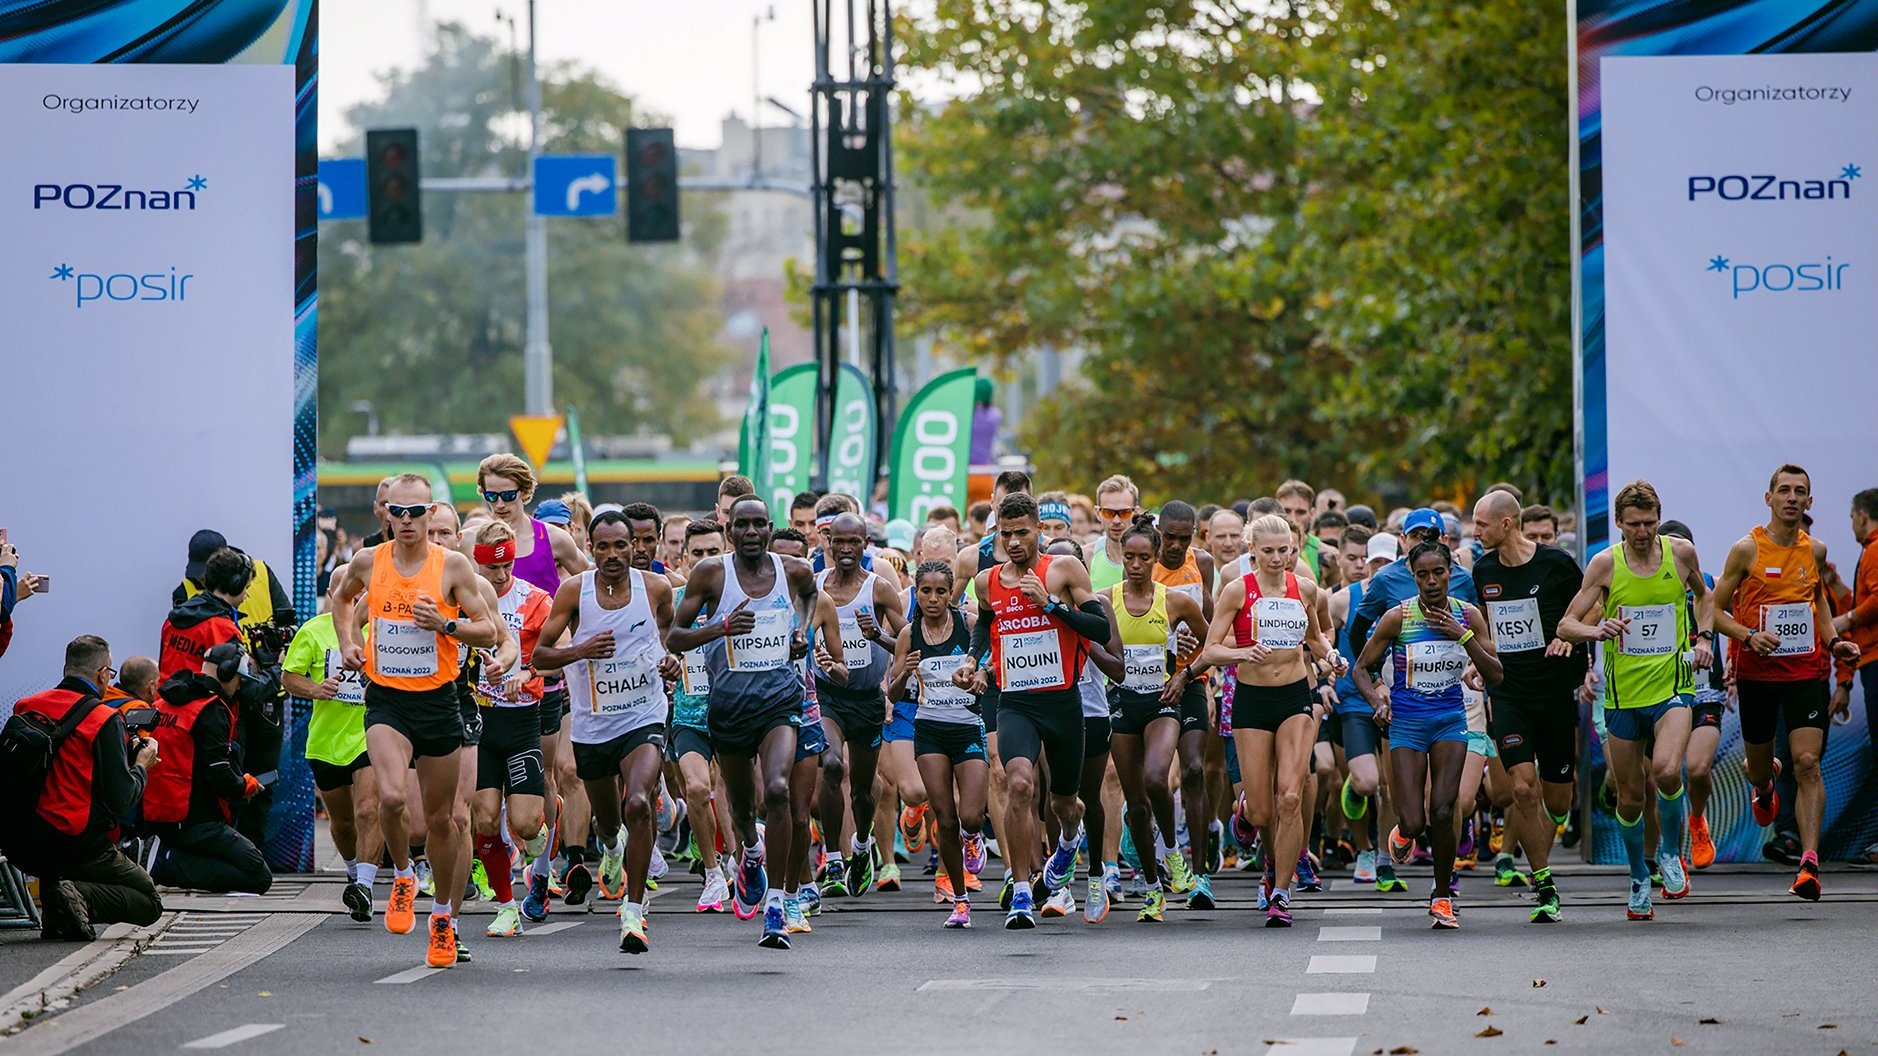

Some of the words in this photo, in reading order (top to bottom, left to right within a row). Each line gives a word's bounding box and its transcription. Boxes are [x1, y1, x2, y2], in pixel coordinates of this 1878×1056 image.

[1695, 85, 1852, 105] Organizatorzy
[42, 94, 200, 114] Organizatorzy
[1268, 601, 1279, 610] 21
[1499, 606, 1508, 616] 21
[1633, 611, 1644, 620] 21
[1778, 609, 1788, 619] 21
[387, 624, 399, 635] 21
[1259, 619, 1306, 630] LINDHOLM
[1496, 618, 1534, 639] KĘSY
[1774, 622, 1808, 637] 3880
[1641, 624, 1658, 637] 57
[169, 633, 206, 656] MEDIA
[733, 635, 787, 650] KIPSAAT
[1013, 638, 1023, 648] 21
[1523, 640, 1539, 649] 2022
[377, 644, 435, 655] GŁOGOWSKI
[1424, 644, 1435, 655] 21
[1628, 645, 1655, 654] POZNAŃ
[1772, 645, 1796, 654] OZNAŃ
[739, 659, 770, 669] POZNAŃ
[849, 659, 865, 667] 2022
[930, 661, 941, 671] 21
[1006, 652, 1059, 670] NOUINI
[1413, 660, 1463, 673] HURISA
[382, 665, 412, 674] POZNAŃ
[413, 667, 431, 675] 2022
[605, 663, 617, 674] 21
[687, 665, 696, 674] EL
[596, 673, 649, 694] CHALA
[1011, 677, 1039, 688] POZNAŃ
[1040, 676, 1058, 685] 2022
[602, 701, 632, 712] POZNAŃ
[926, 697, 953, 706] POZNAŃ
[954, 697, 970, 705] 2022
[155, 712, 179, 727] EDIA
